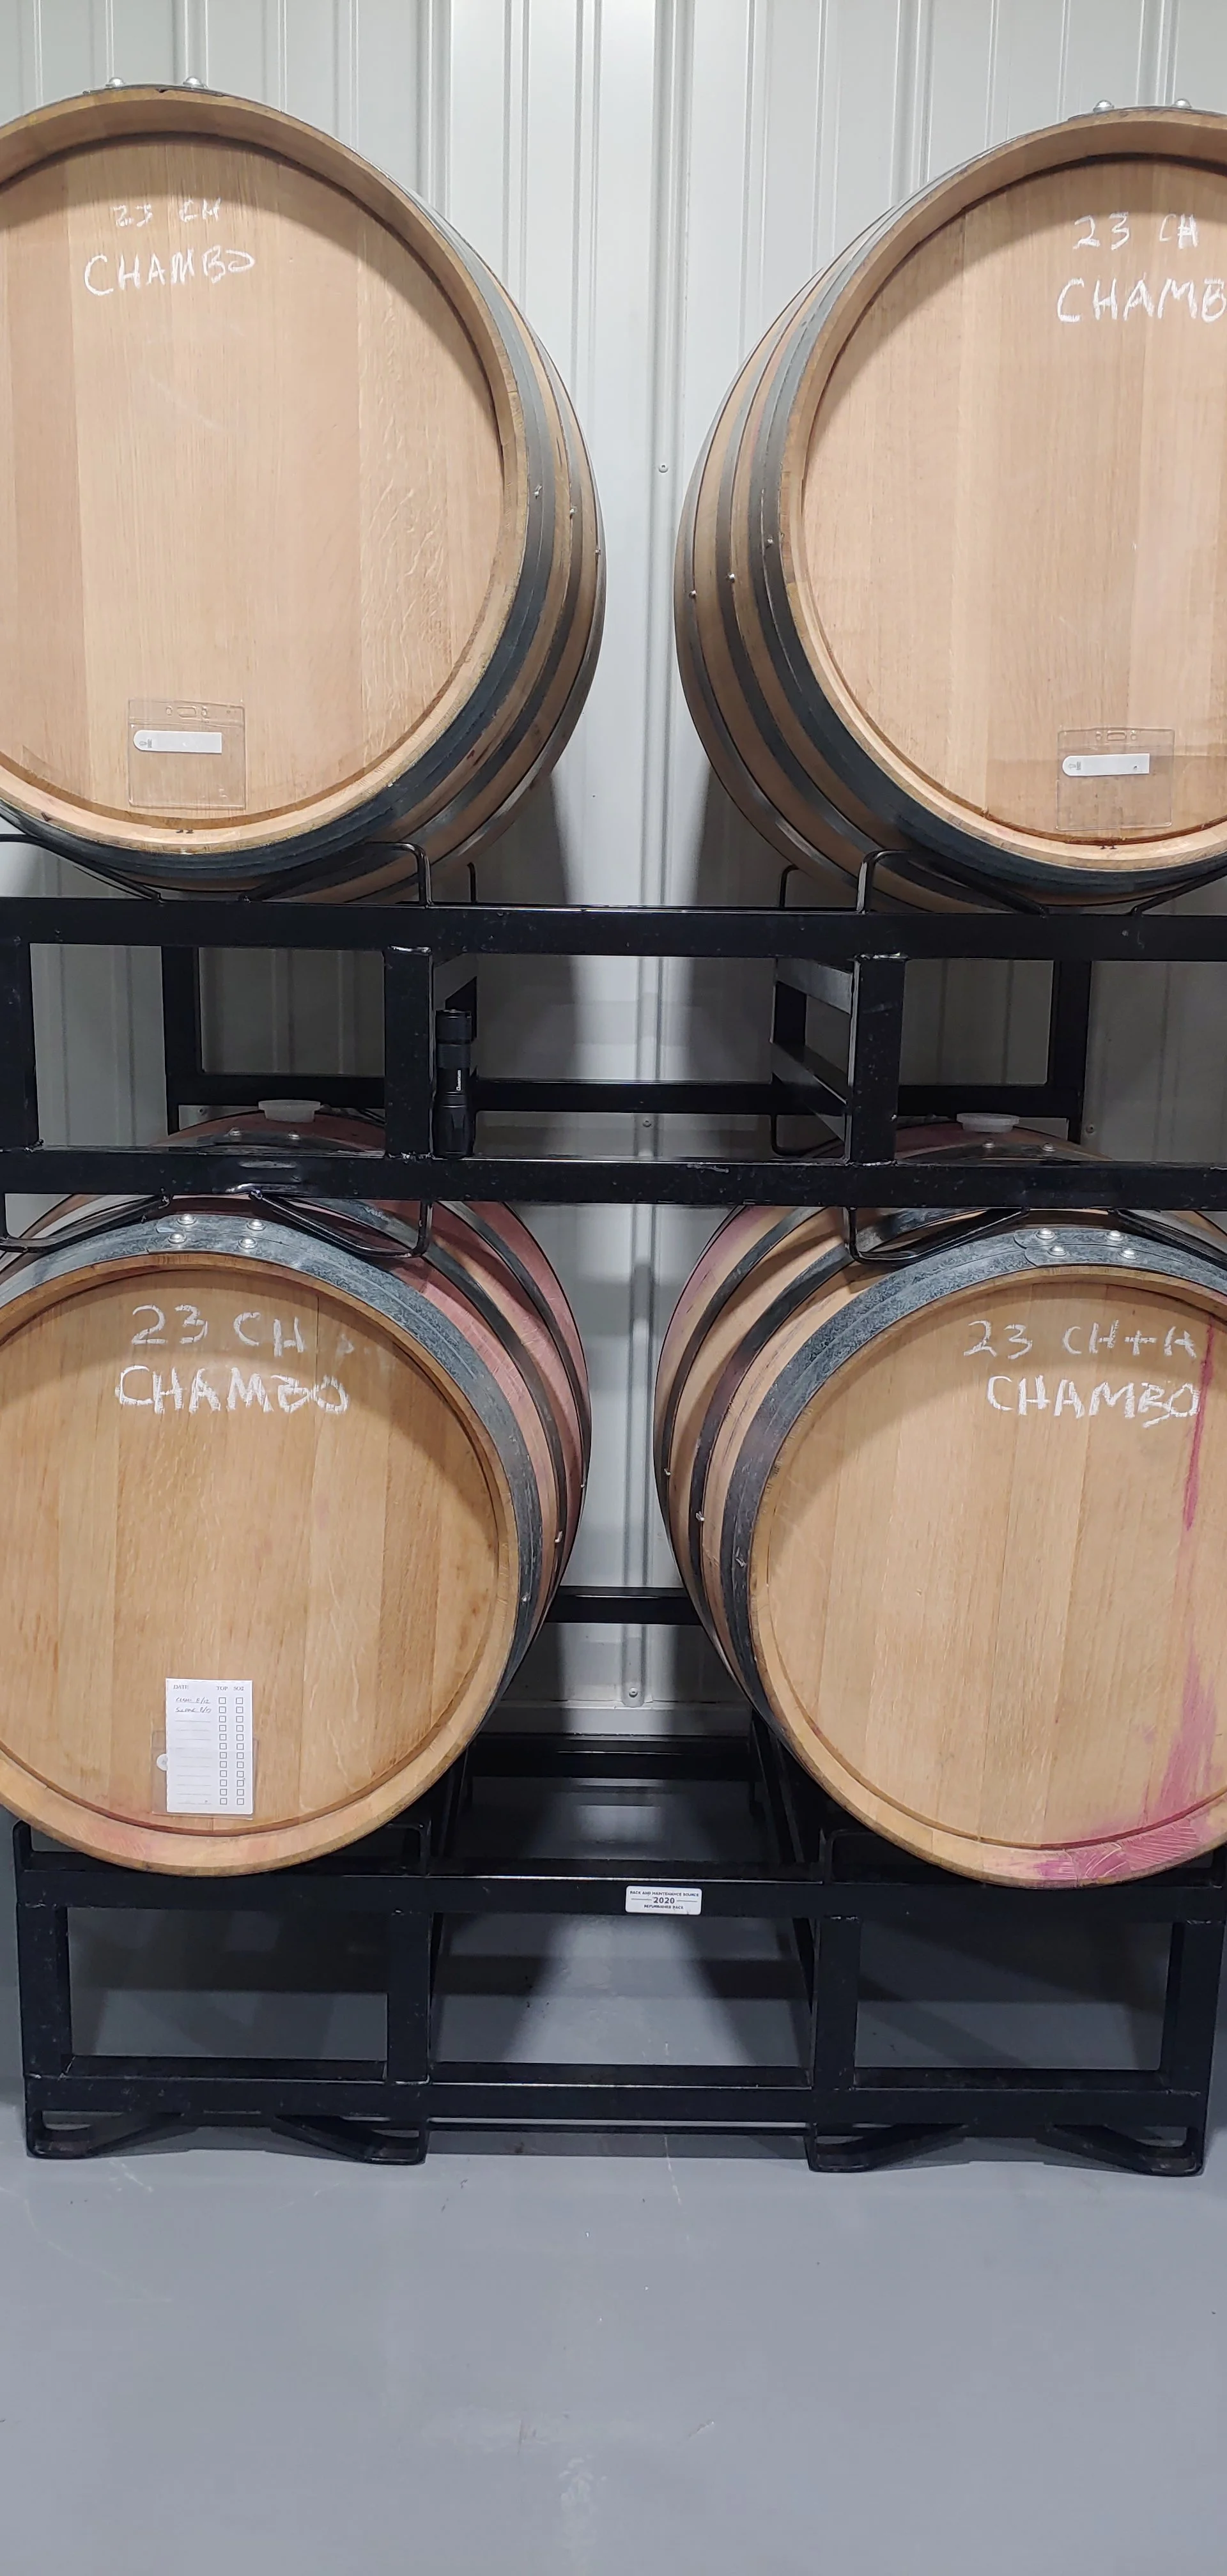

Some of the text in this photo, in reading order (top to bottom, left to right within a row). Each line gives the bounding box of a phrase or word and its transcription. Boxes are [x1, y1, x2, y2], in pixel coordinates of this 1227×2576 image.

[1073, 211, 1199, 250] 23 CH
[84, 245, 256, 296] CHAMBO
[132, 1304, 305, 1357] 23 CH
[964, 1319, 1033, 1360] 23
[115, 1365, 350, 1414] CHAMBO
[987, 1374, 1201, 1429] CHAMBO
